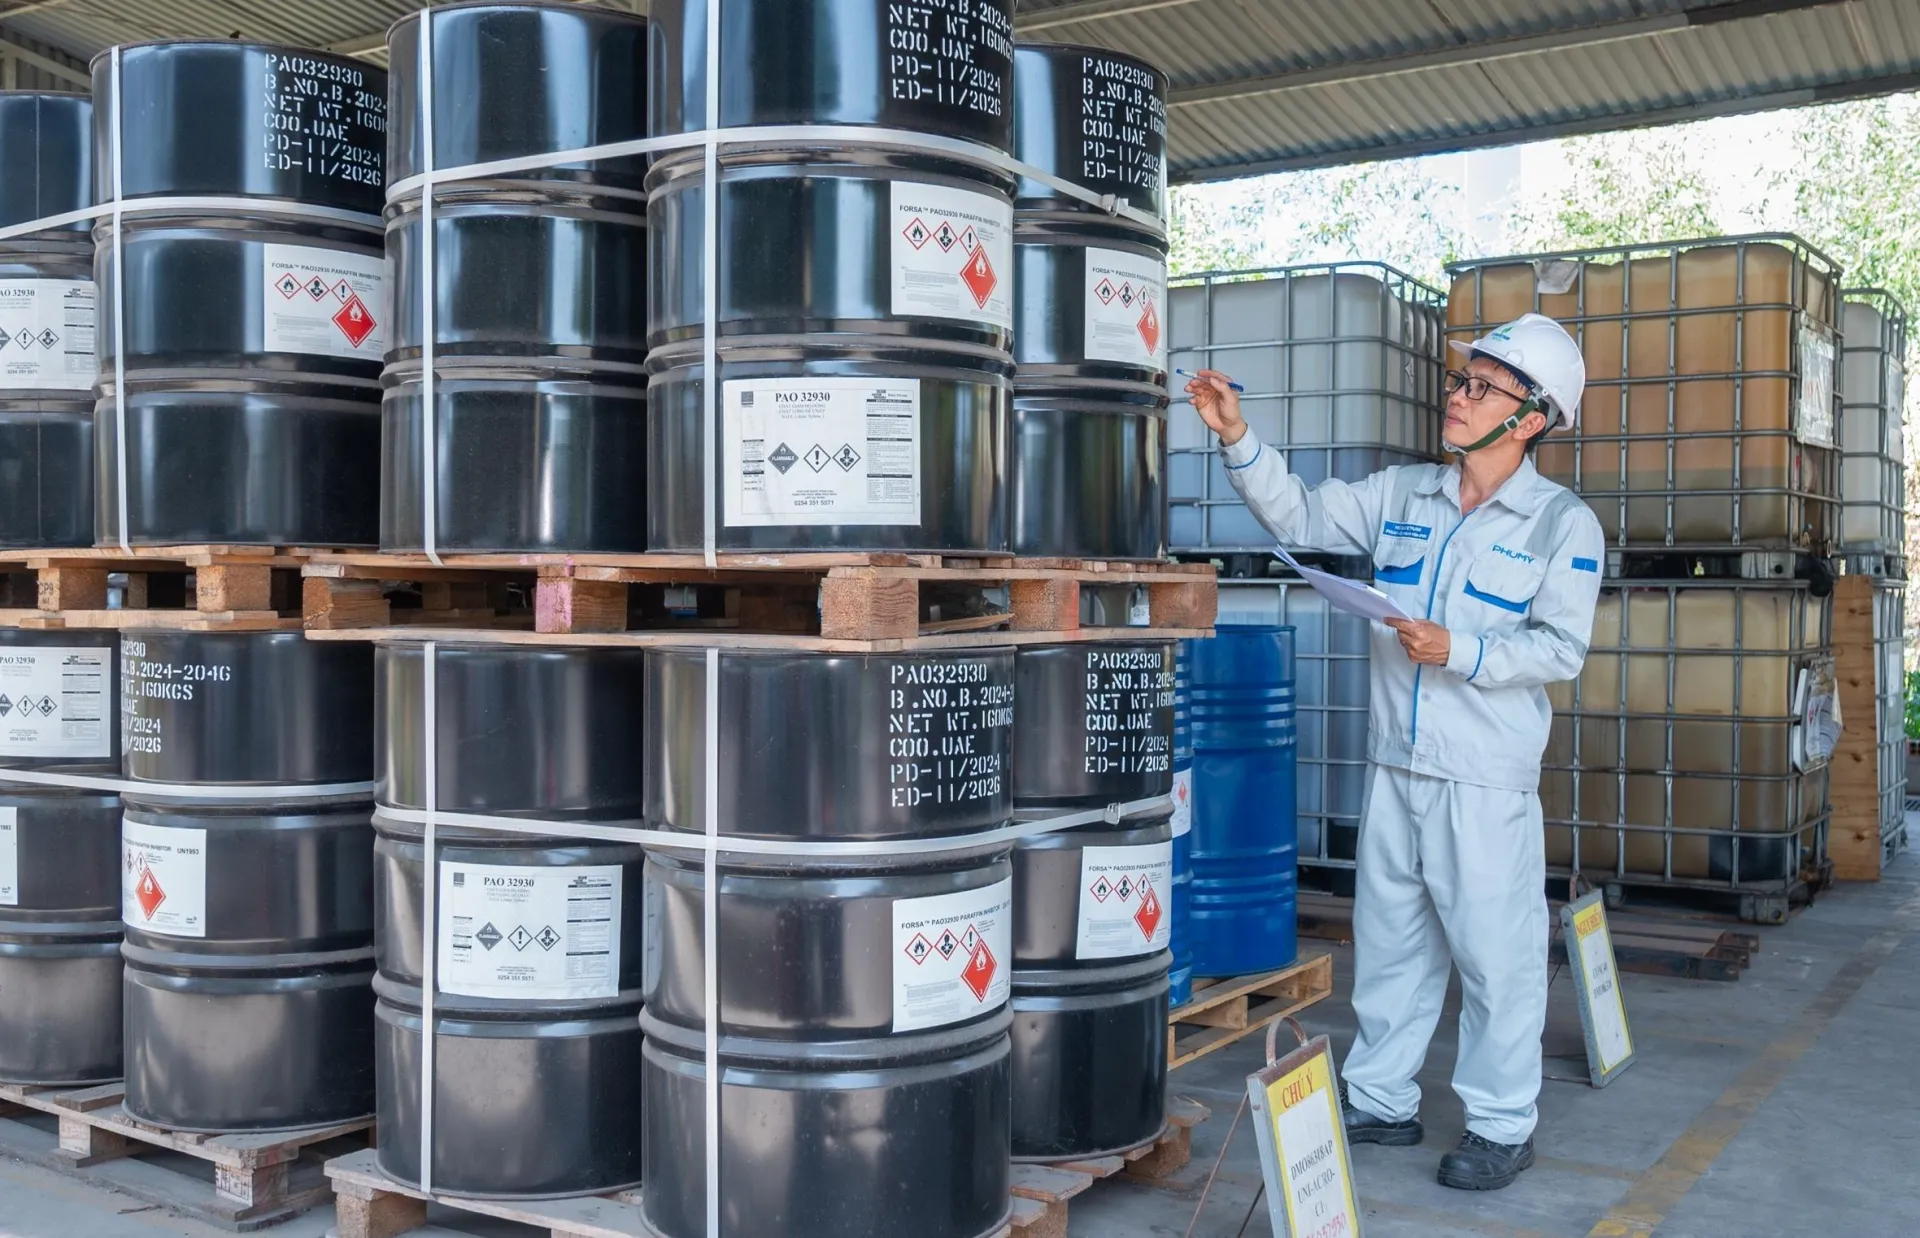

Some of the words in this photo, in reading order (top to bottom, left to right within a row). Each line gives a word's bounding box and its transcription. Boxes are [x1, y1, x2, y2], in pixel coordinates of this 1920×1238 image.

[890, 4, 932, 29] NET
[892, 54, 1000, 94] PD-11/2024
[264, 92, 304, 113] NET
[1083, 98, 1115, 119] NET
[264, 134, 380, 168] PD-11/2024
[776, 392, 798, 402] PAO
[800, 392, 830, 402] 32930
[1086, 693, 1121, 710] NET
[890, 713, 933, 733] NET
[1085, 735, 1168, 752] PD-11/2024
[891, 753, 1000, 783] PD-11/2024
[484, 877, 505, 886] PAO
[507, 877, 534, 887] 32930
[1283, 1073, 1305, 1108] CHÚ
